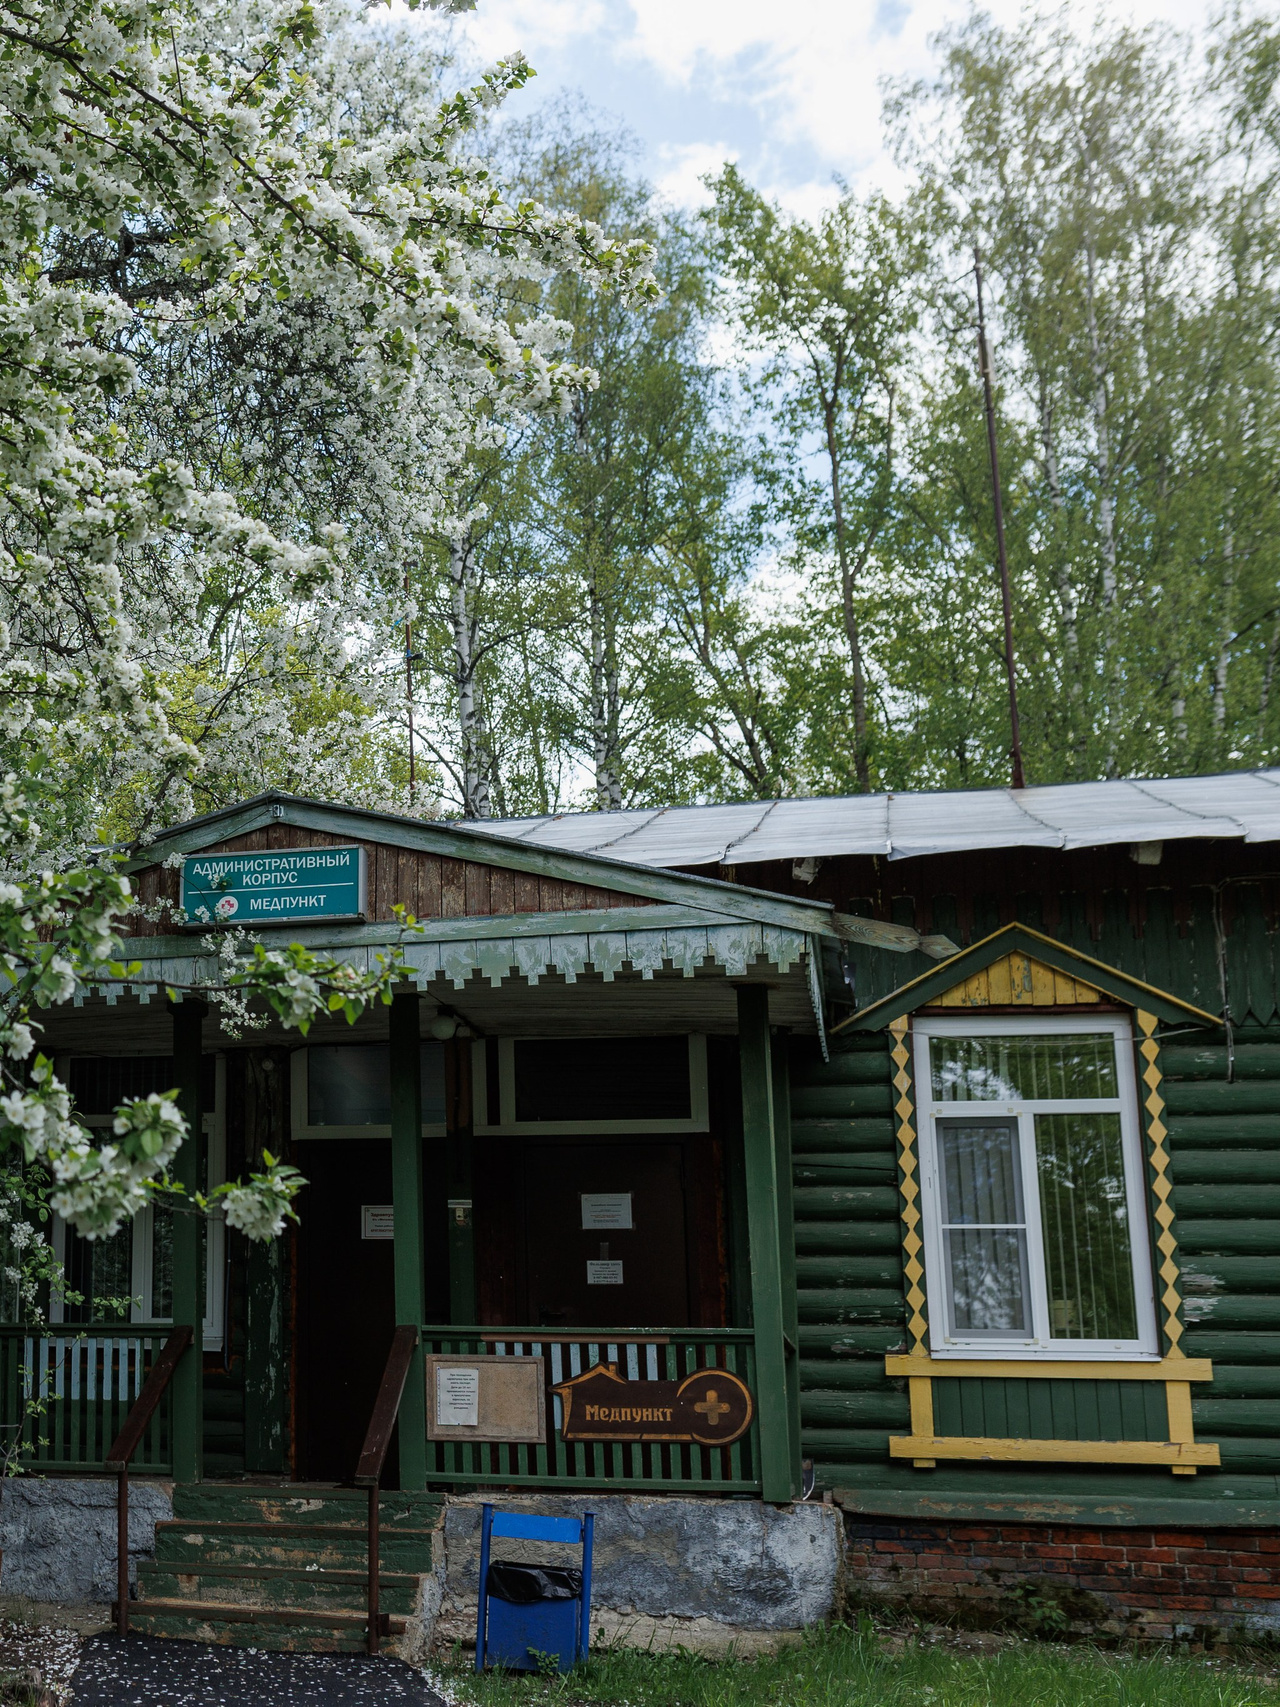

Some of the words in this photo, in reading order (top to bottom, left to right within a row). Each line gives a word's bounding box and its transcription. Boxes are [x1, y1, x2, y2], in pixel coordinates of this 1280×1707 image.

[192, 851, 350, 876] АДМИНИСТРАТИВНЫЙ
[242, 871, 298, 886] КОРПУС
[250, 894, 327, 911] МЕДПУНКТ
[585, 1404, 673, 1423] Медпункт
